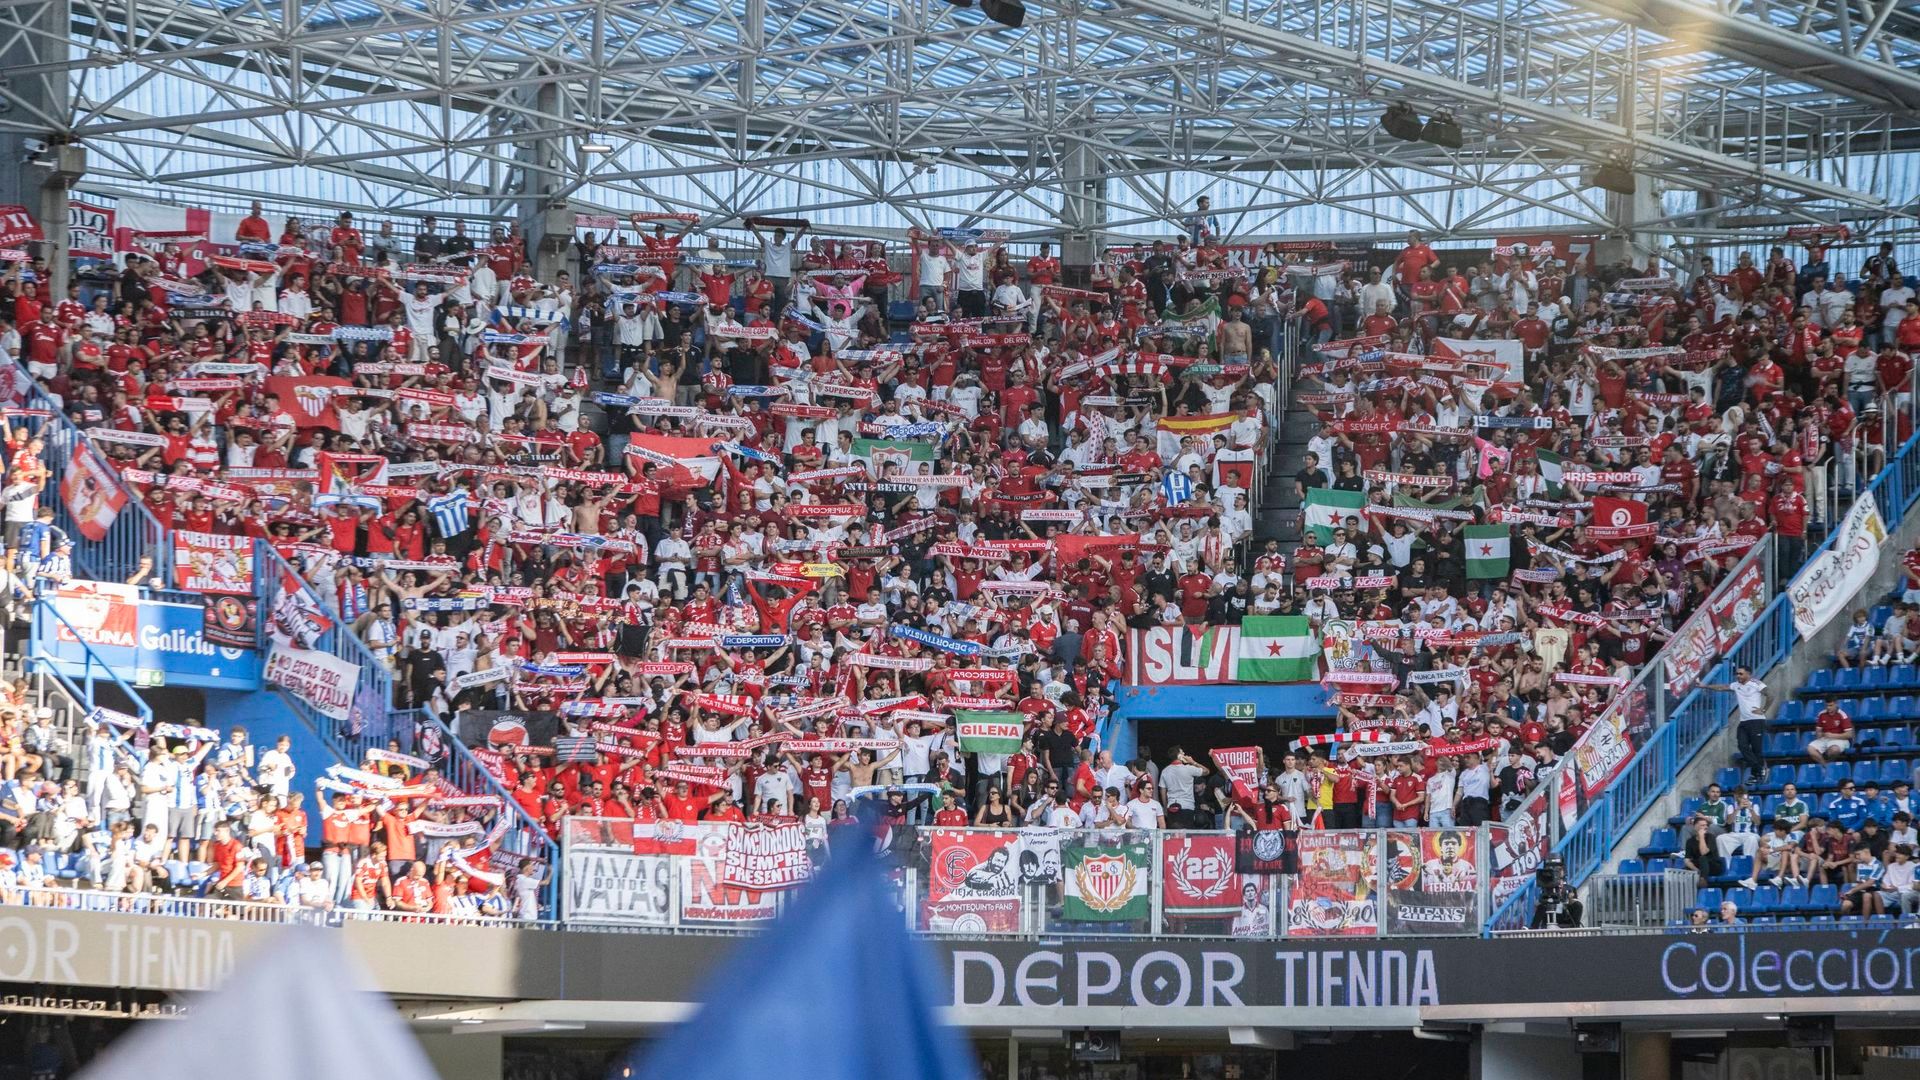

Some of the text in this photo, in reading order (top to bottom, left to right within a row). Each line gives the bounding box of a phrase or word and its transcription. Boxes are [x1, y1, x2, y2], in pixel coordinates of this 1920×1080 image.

[952, 326, 962, 334] DEL
[983, 337, 997, 346] COPA
[1004, 336, 1015, 344] DEL
[1016, 336, 1029, 344] REY
[824, 385, 873, 398] SUPERCOPA
[638, 406, 661, 414] NUNCA
[674, 407, 692, 415] RINDO
[1350, 423, 1391, 431] SEVILLA FC
[1474, 416, 1489, 427] 19
[101, 430, 123, 439] NUNCA
[545, 468, 581, 480] ULTRAS
[587, 471, 623, 482] SEVILLA
[1378, 472, 1439, 485] SAN JUAN
[844, 483, 917, 491] ANTI BETICO
[179, 530, 250, 549] FUENTES DE
[936, 544, 1003, 558] BIRIS NORTE
[1018, 542, 1047, 550] SALERO
[1310, 577, 1386, 588] BIRIS NORTE
[1538, 605, 1559, 617] FINAL
[61, 628, 137, 646] OSUNA
[903, 626, 968, 651] DEPORTIVISTA
[1367, 627, 1446, 638] BIRIS NORTE
[726, 636, 782, 645] RCDEPORTIVO
[278, 655, 342, 688] NO ESTAS SOLO
[645, 664, 676, 672] SEVILLA
[1414, 673, 1435, 681] NUNCA
[1445, 670, 1463, 678] RINDA
[304, 680, 349, 710] BATALLA
[500, 715, 526, 728] CORUÑA
[611, 725, 641, 735] DONDE
[961, 724, 1020, 738] GILENA
[596, 742, 644, 758] ONDE VAYAS
[677, 747, 710, 756] SEVILLA
[711, 746, 738, 756] FÚTBOL
[791, 741, 825, 749] SEVILLA
[834, 741, 848, 749] F.C.
[1359, 745, 1381, 754] NUNCA
[1391, 743, 1413, 752] RINDAS
[1434, 742, 1486, 754] NUNCA TE RINDAS
[676, 772, 707, 783] DONDE
[728, 824, 805, 856] SANCIONADOS
[1303, 835, 1359, 848] CANTILLNA
[726, 851, 807, 871] SIEMPRE
[1090, 864, 1102, 873] 22
[1187, 857, 1219, 880] 22
[725, 864, 809, 886] PRESENTES
[594, 877, 648, 892] DONDE
[1428, 881, 1472, 892] TERRAZA
[950, 888, 974, 898] VIEJA
[976, 886, 1015, 898] GUARDIA
[995, 902, 1013, 911] FANS
[727, 907, 775, 919] WARRIORS
[1352, 905, 1373, 923] 90
[1424, 908, 1464, 921] FANS
[105, 924, 236, 992] TIENDA
[1276, 950, 1440, 1007] TIENDA
